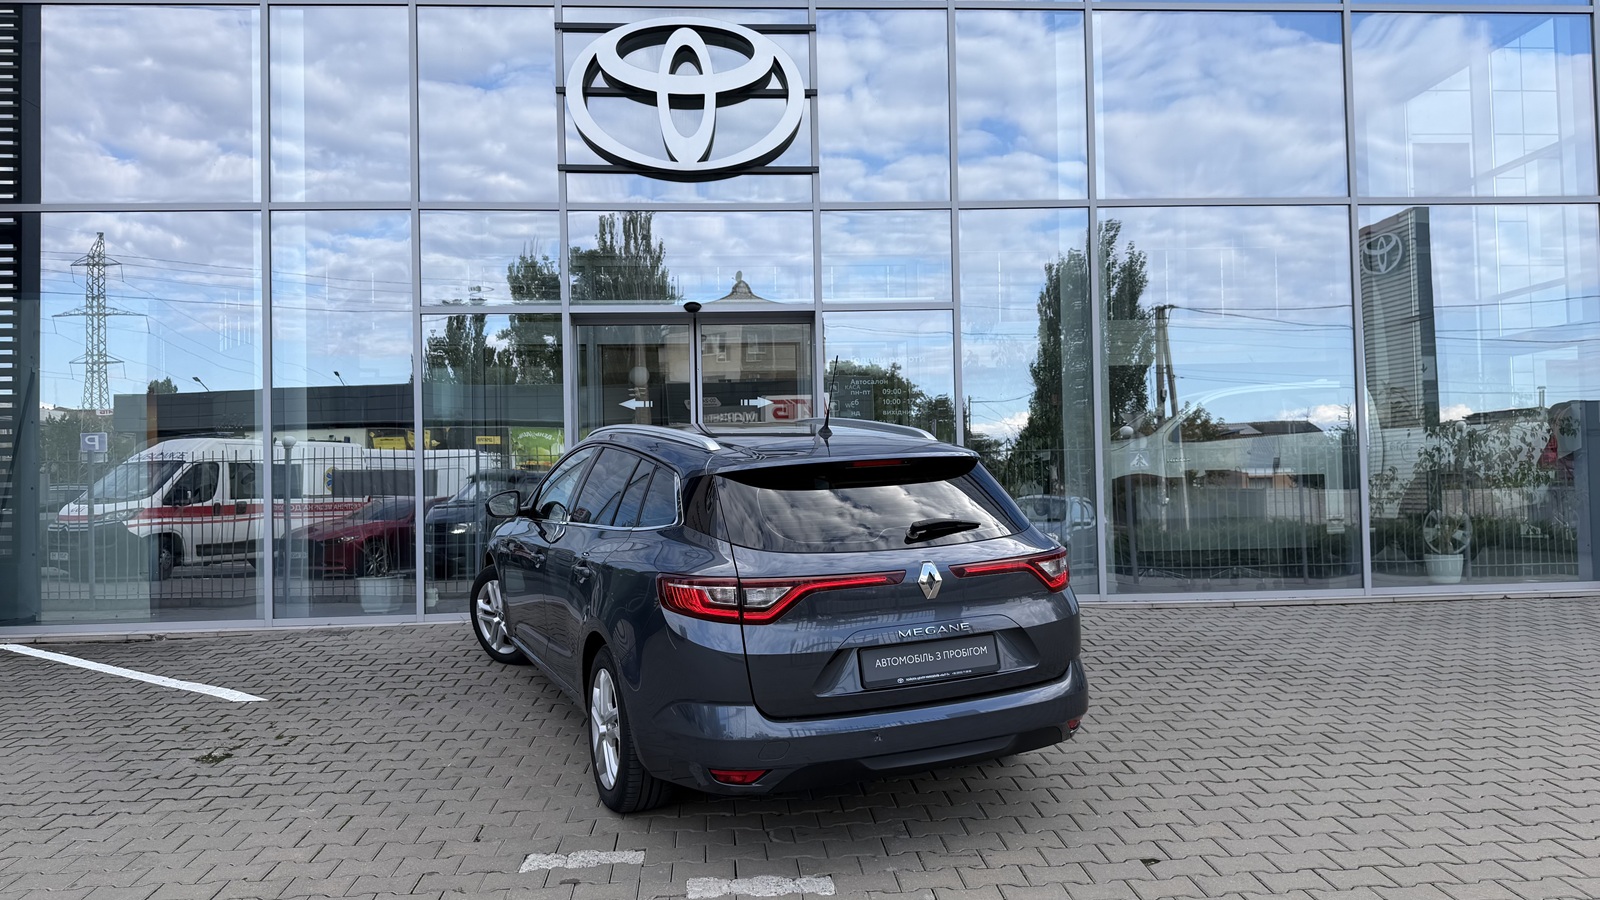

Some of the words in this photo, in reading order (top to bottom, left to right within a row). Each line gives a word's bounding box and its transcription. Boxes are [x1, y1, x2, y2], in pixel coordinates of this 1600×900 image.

[850, 378, 889, 386] Автосалон
[850, 398, 860, 406] сб
[882, 398, 902, 406] 10:00
[898, 622, 970, 638] MEGANE
[875, 653, 934, 668] АВТОМОБІЛЬ
[943, 645, 988, 660] ПРОБІГОМ
